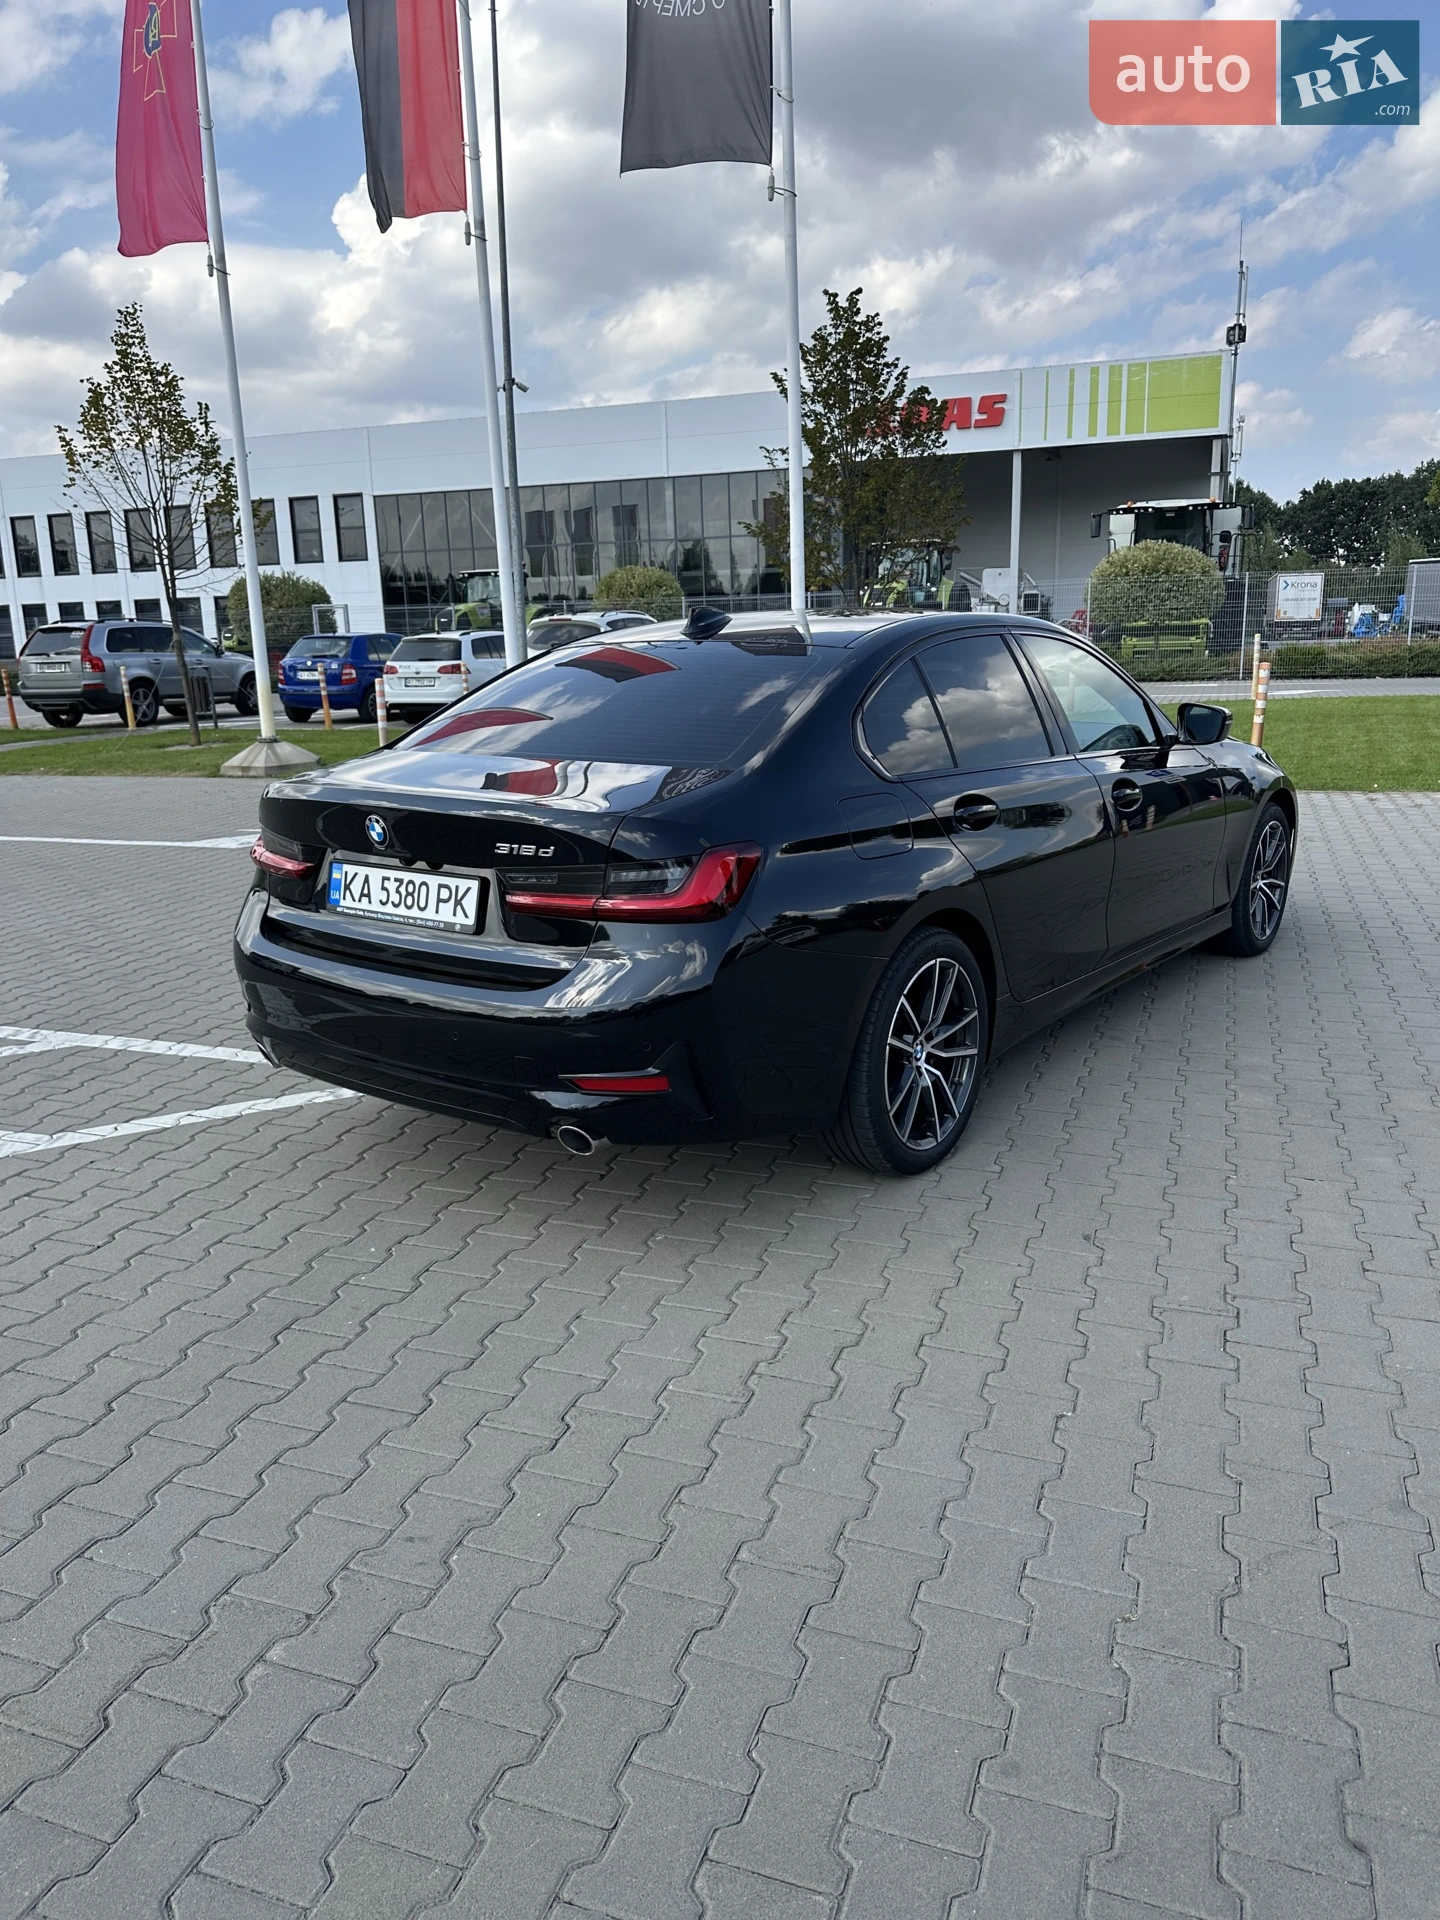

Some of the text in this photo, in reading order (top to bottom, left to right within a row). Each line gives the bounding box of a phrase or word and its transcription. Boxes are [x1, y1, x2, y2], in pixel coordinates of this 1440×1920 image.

[1290, 580, 1318, 589] Krona
[330, 889, 340, 900] UA
[342, 870, 473, 919] KA 5380 PK
